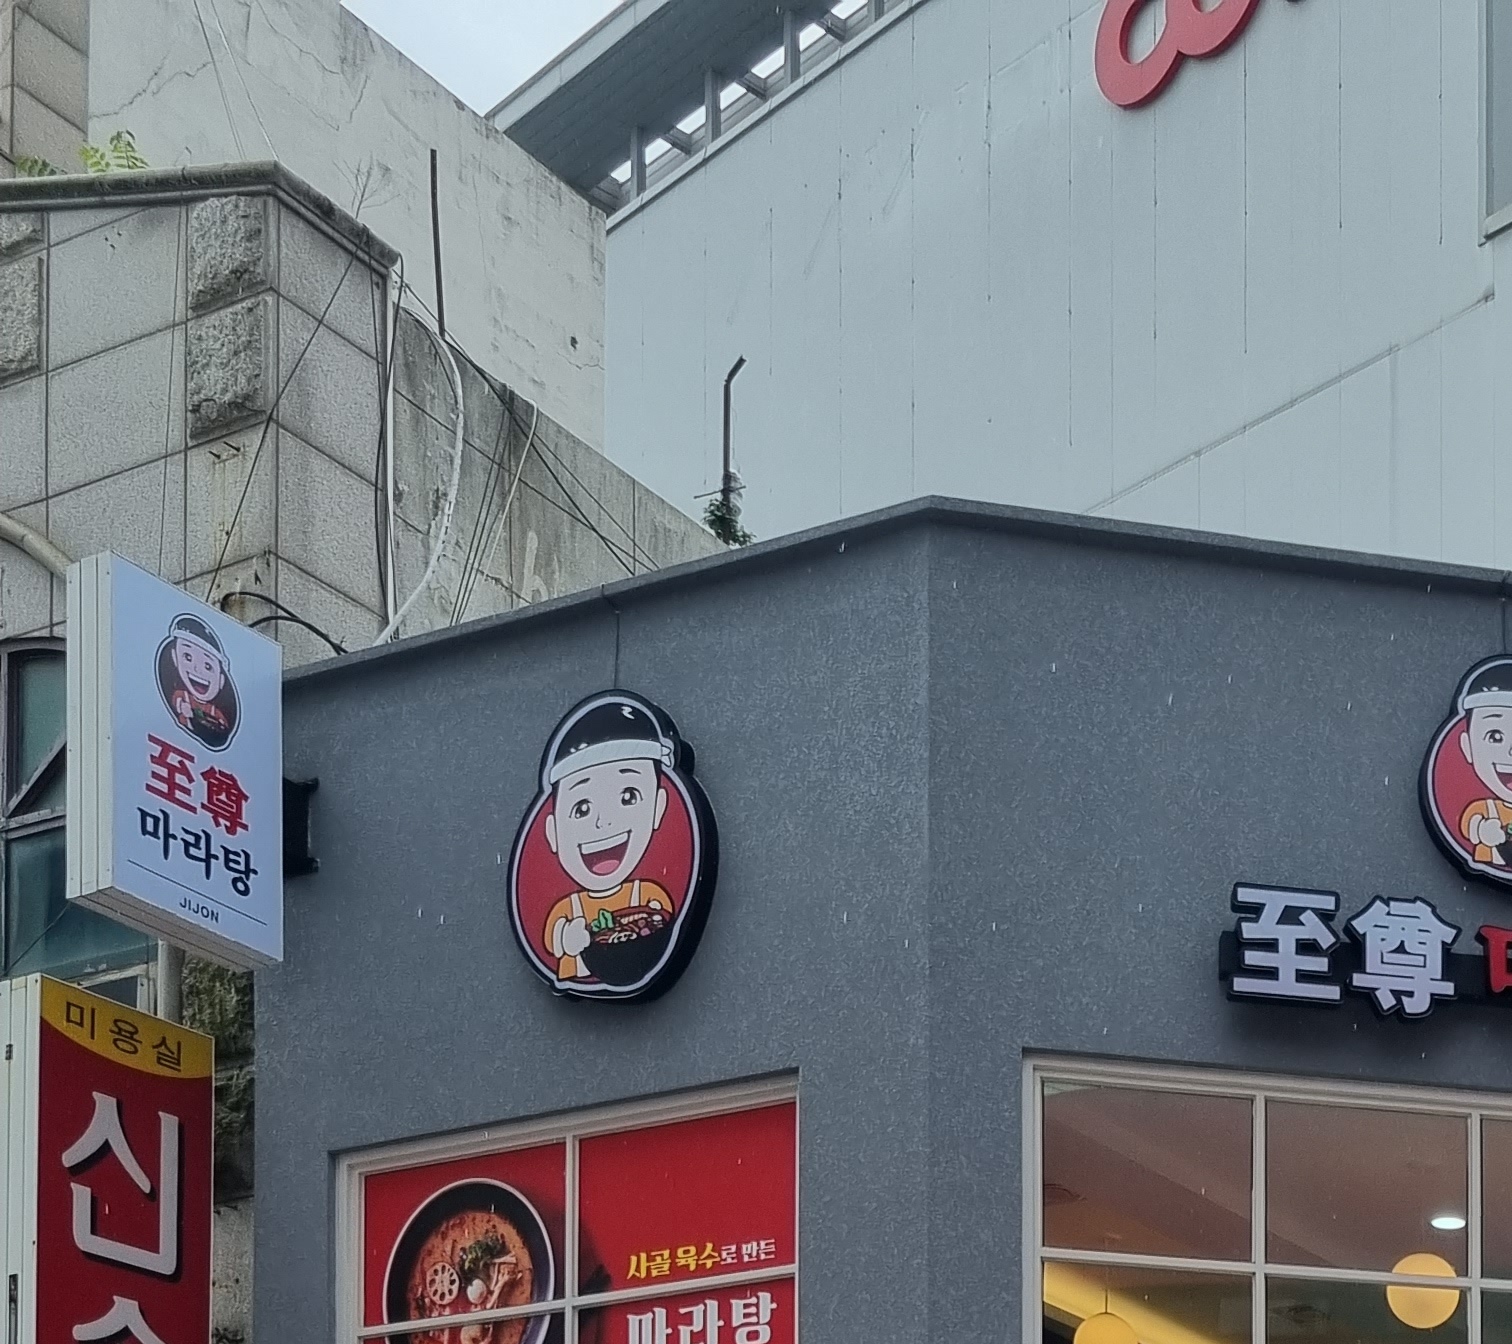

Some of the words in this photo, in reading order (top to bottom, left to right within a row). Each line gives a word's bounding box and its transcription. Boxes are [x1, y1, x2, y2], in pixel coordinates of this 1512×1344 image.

[145, 733, 250, 837] 至尊
[137, 807, 258, 897] 마라탕
[179, 896, 219, 924] JIJON
[1233, 887, 1460, 1015] 至尊
[64, 1000, 182, 1073] 미용실
[627, 1248, 672, 1280] 사골
[675, 1242, 738, 1272] 육수로
[741, 1238, 777, 1263] 만든
